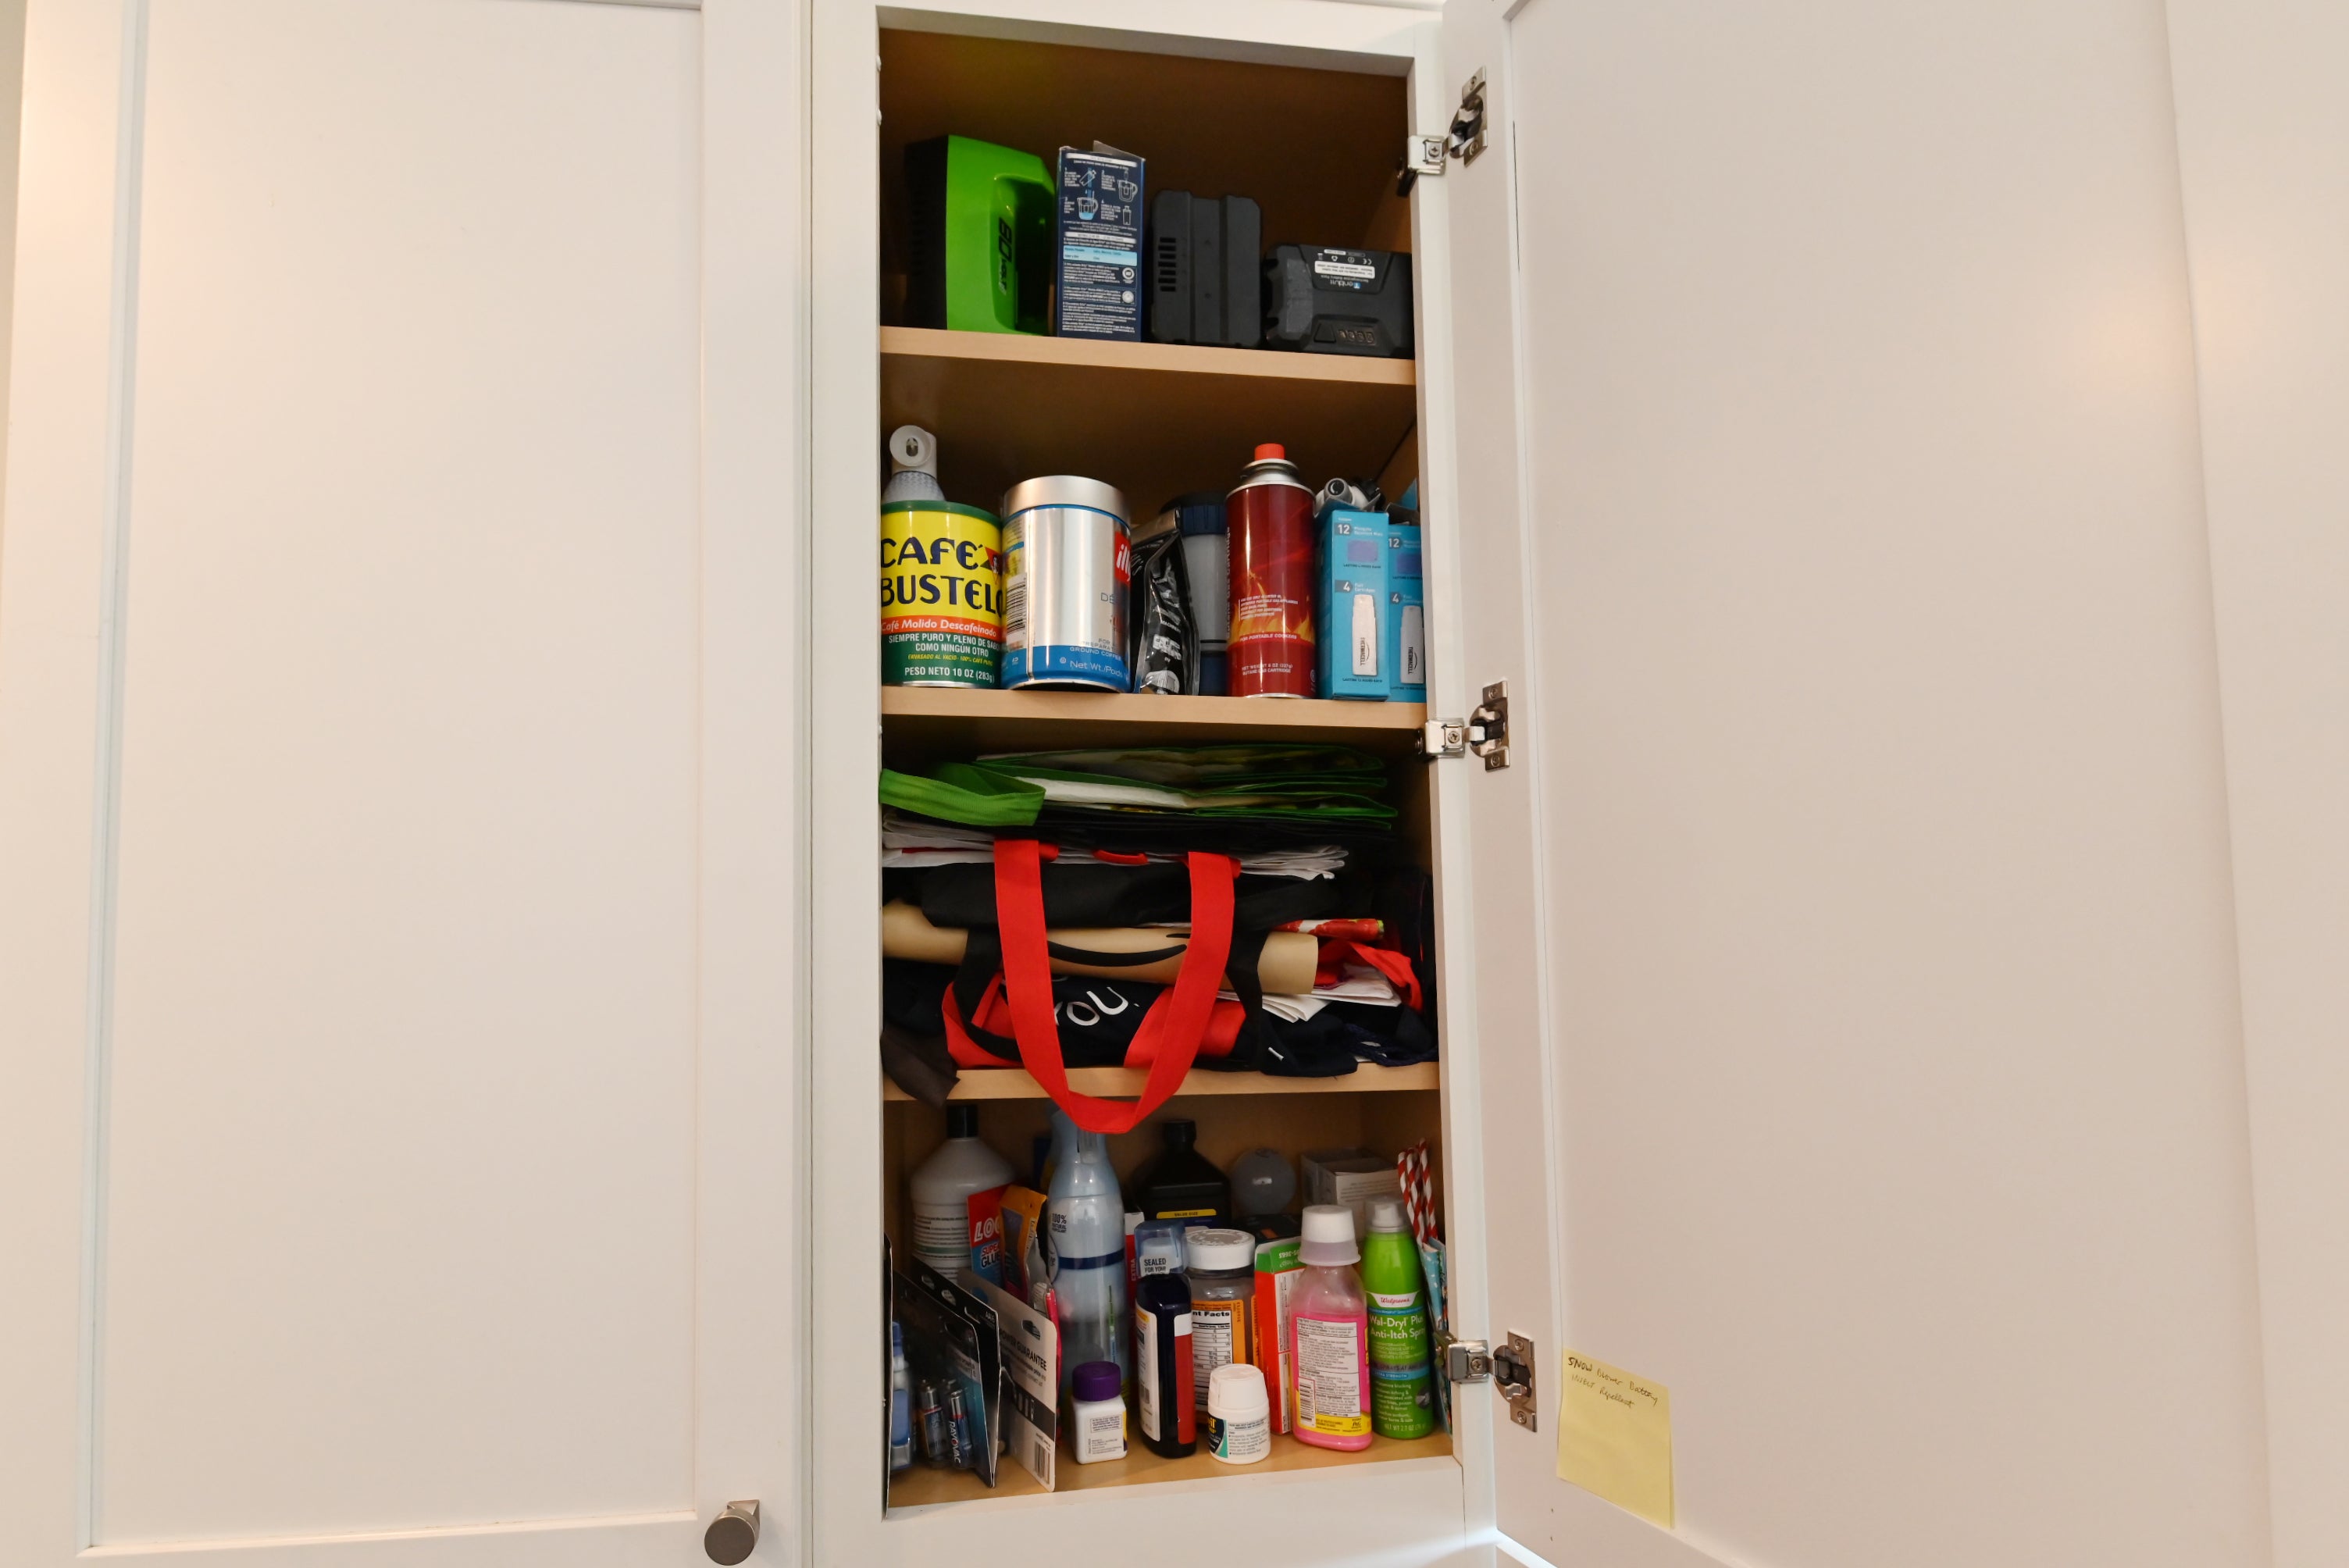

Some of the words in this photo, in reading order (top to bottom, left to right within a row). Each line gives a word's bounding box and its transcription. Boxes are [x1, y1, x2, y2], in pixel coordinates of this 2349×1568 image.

[1338, 524, 1350, 535] 12
[1388, 538, 1400, 547] 12
[1343, 581, 1350, 592] 4
[1392, 593, 1399, 603] 4
[901, 619, 937, 629] Molido
[940, 619, 996, 637] Descafeinado
[889, 633, 920, 643] SIEMPRE
[922, 633, 944, 642] PURO
[954, 634, 976, 645] PLENO
[978, 637, 986, 647] DE
[987, 640, 1000, 650] SABO
[941, 643, 970, 654] NINGÚN
[972, 648, 989, 657] OTRO
[1070, 661, 1088, 669] Net
[904, 667, 925, 675] PESO
[928, 667, 950, 675] NETO
[964, 669, 974, 678] OZ
[976, 671, 995, 683] (283g)
[981, 1254, 1000, 1268] GLUE
[1371, 1327, 1408, 1339] Anti-Itch
[1016, 1342, 1047, 1370] GUARANTEE
[949, 1420, 961, 1464] RAYOVAC
